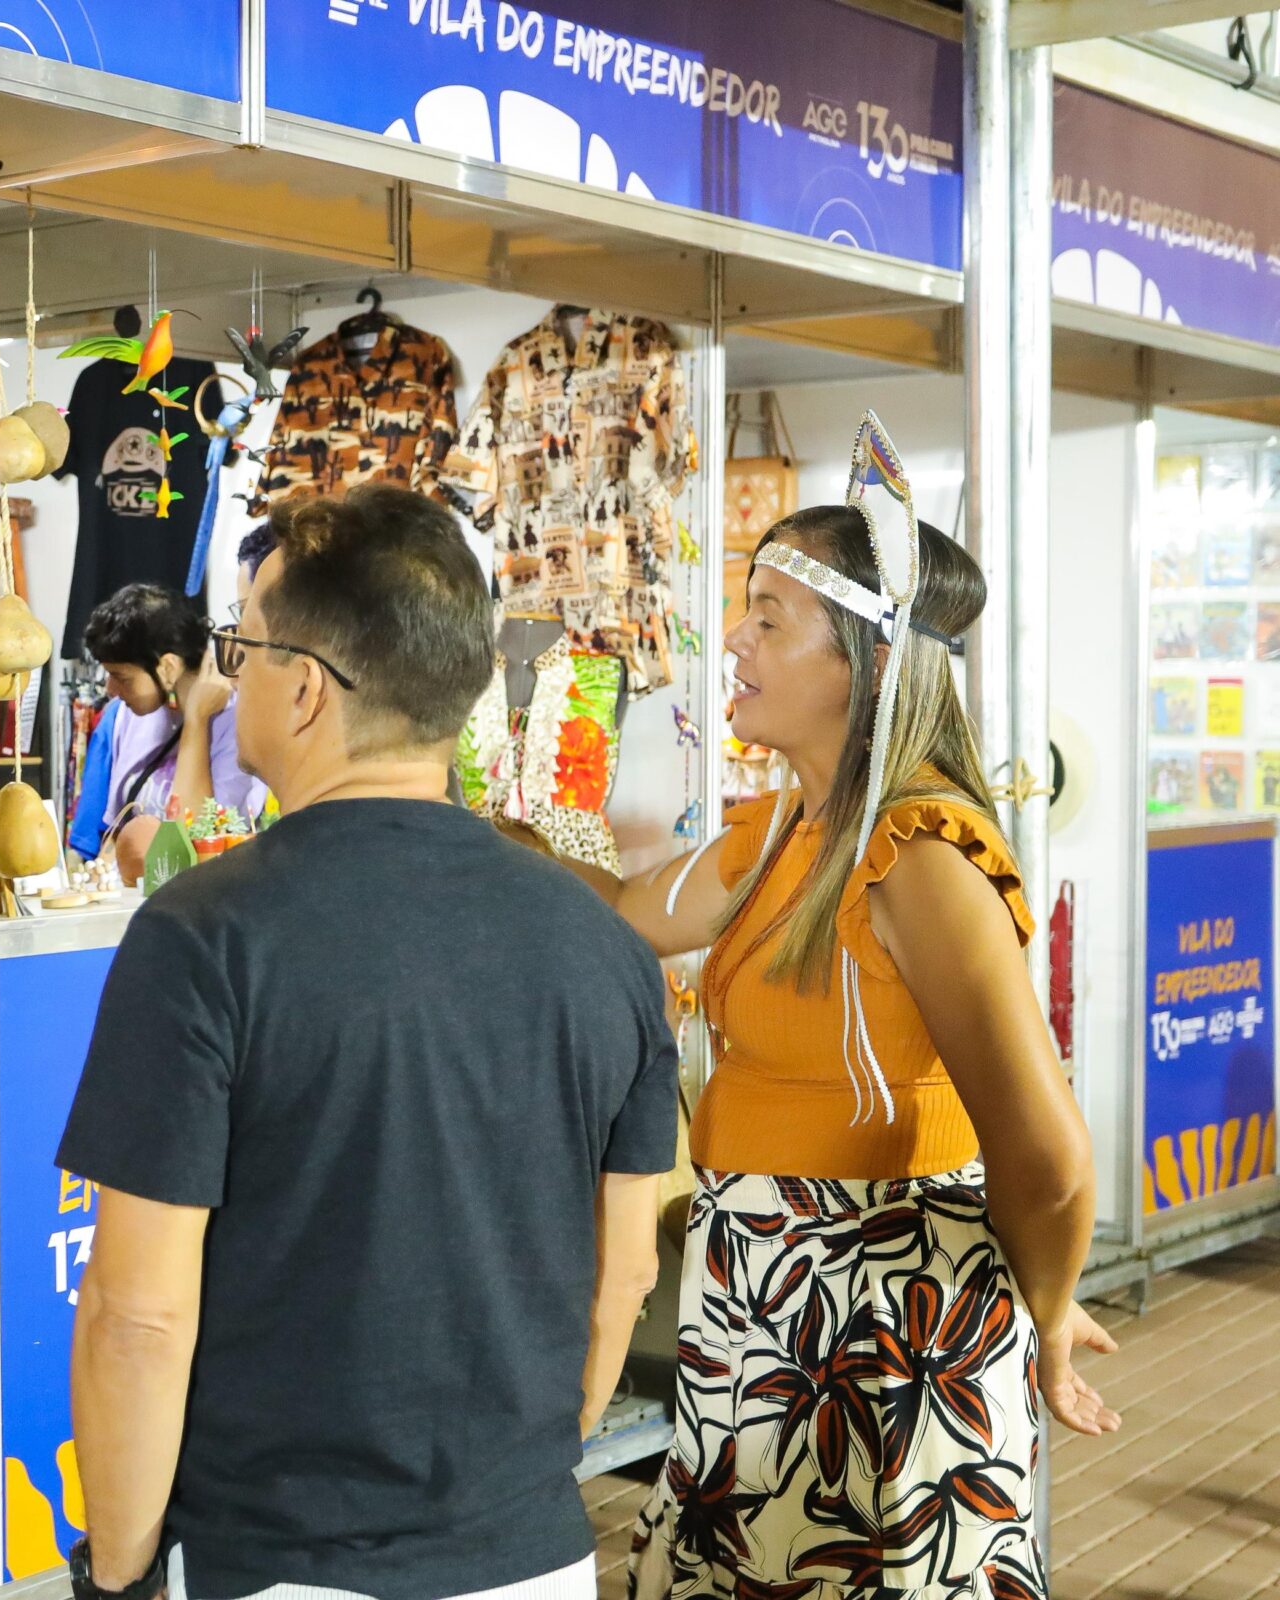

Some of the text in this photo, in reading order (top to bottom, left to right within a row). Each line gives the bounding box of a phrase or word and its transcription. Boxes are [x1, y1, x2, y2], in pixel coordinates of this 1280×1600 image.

[497, 1, 545, 58] DO
[553, 19, 783, 138] EMPREENDEDOR
[856, 100, 910, 179] 130
[1095, 185, 1124, 226] DO
[1126, 195, 1257, 272] EMPREENDEDOR
[1179, 916, 1234, 954] VILA DO
[1155, 957, 1262, 1006] EMPREENDEDOR
